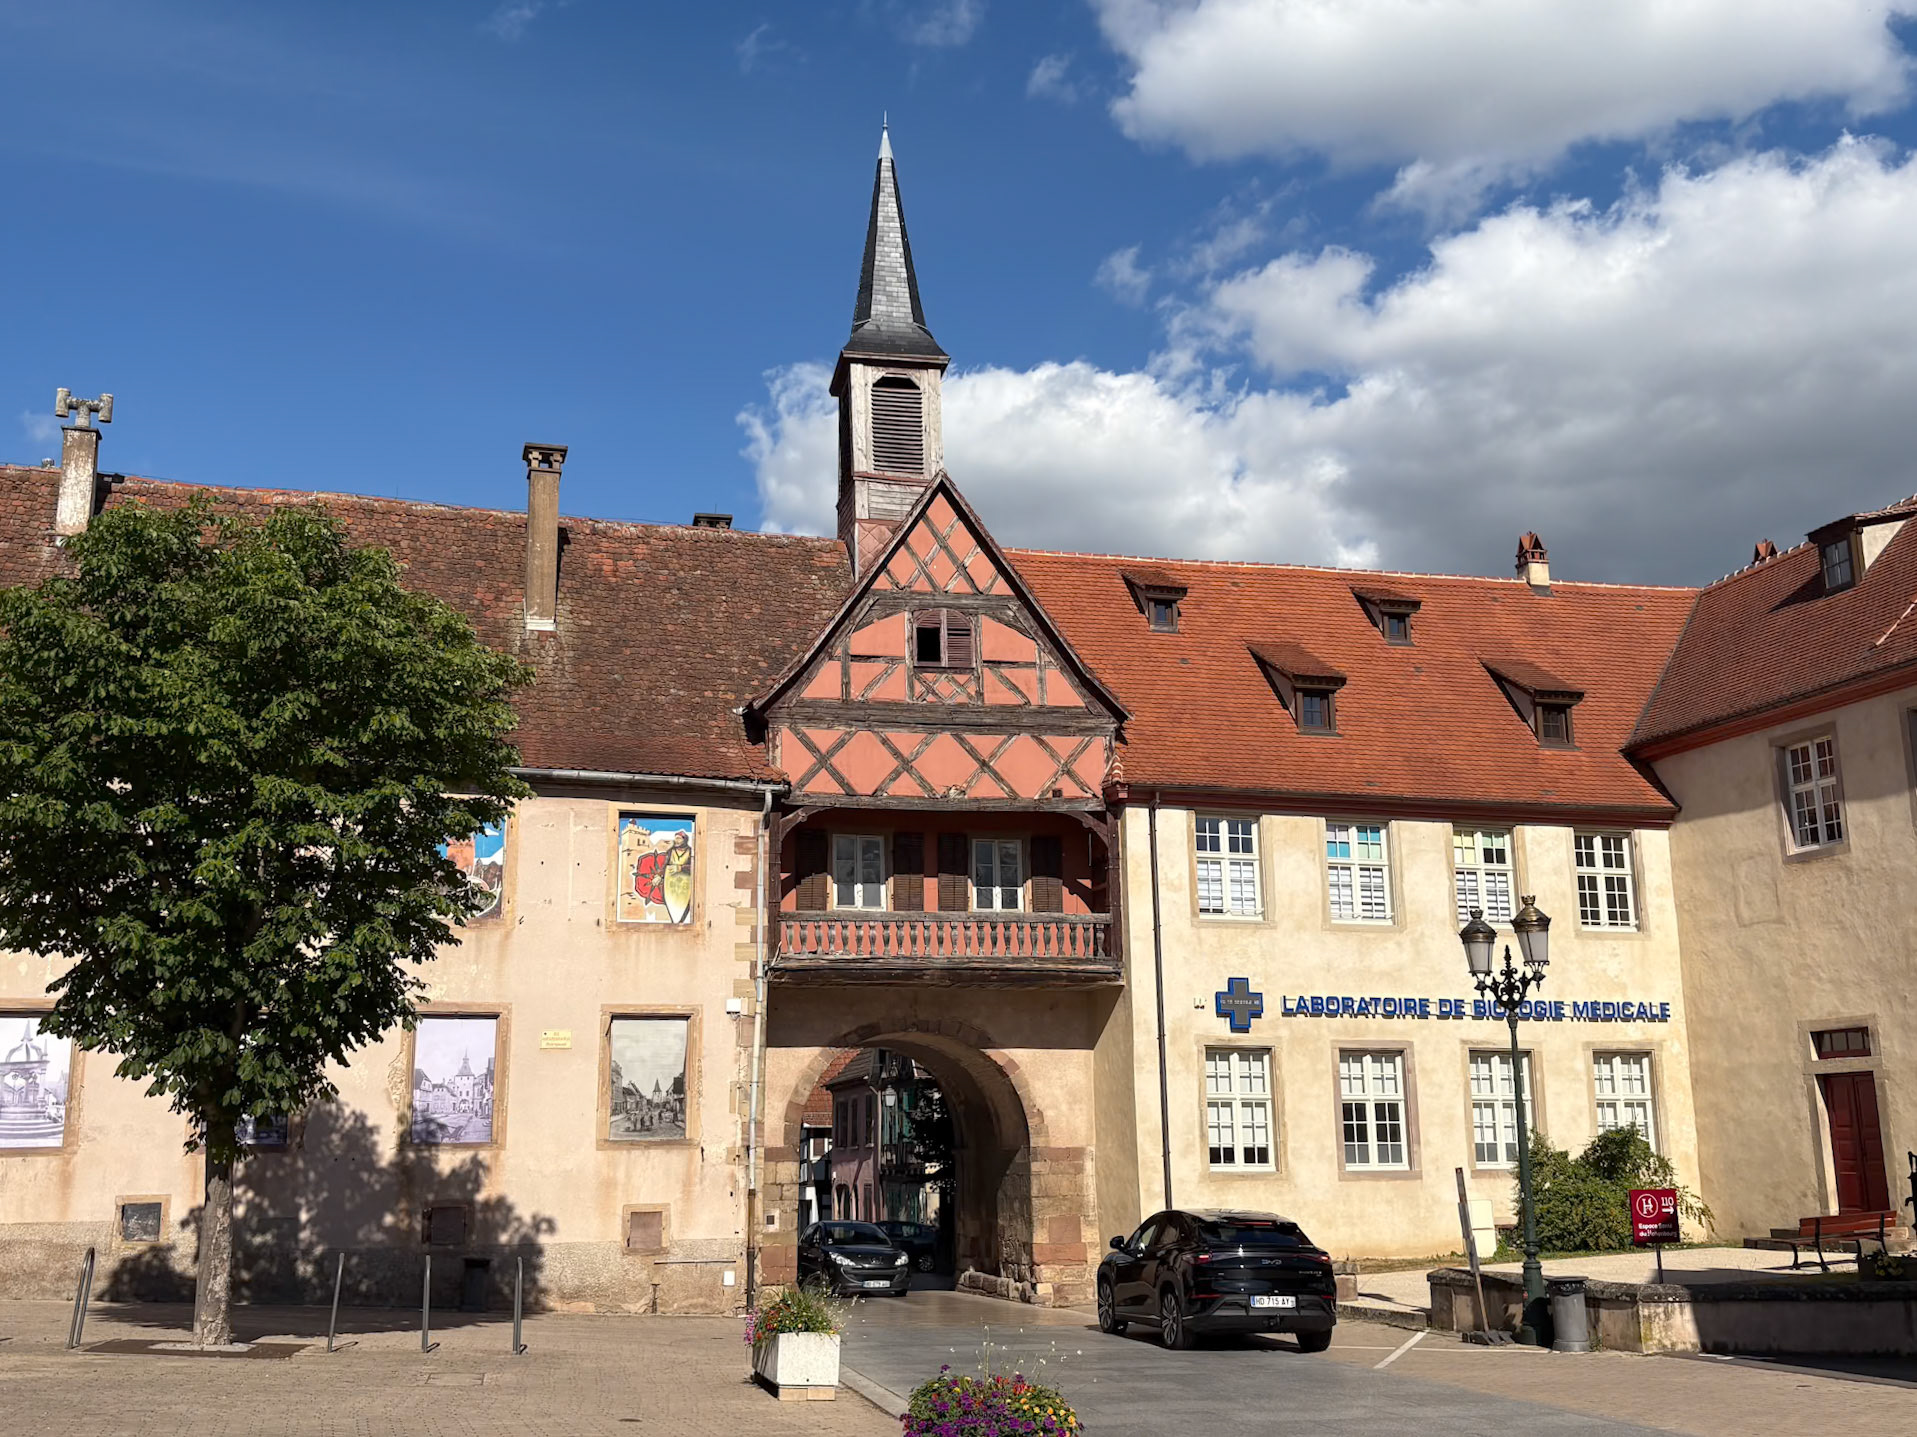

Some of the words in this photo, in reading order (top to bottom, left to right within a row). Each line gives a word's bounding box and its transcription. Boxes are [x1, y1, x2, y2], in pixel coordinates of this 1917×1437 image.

[1282, 995, 1430, 1016] LABORATOIRE
[1438, 998, 1466, 1016] DE
[1473, 999, 1566, 1018] BIOOGIE
[1572, 1000, 1671, 1019] MÉDICALE
[1661, 1197, 1674, 1206] 110
